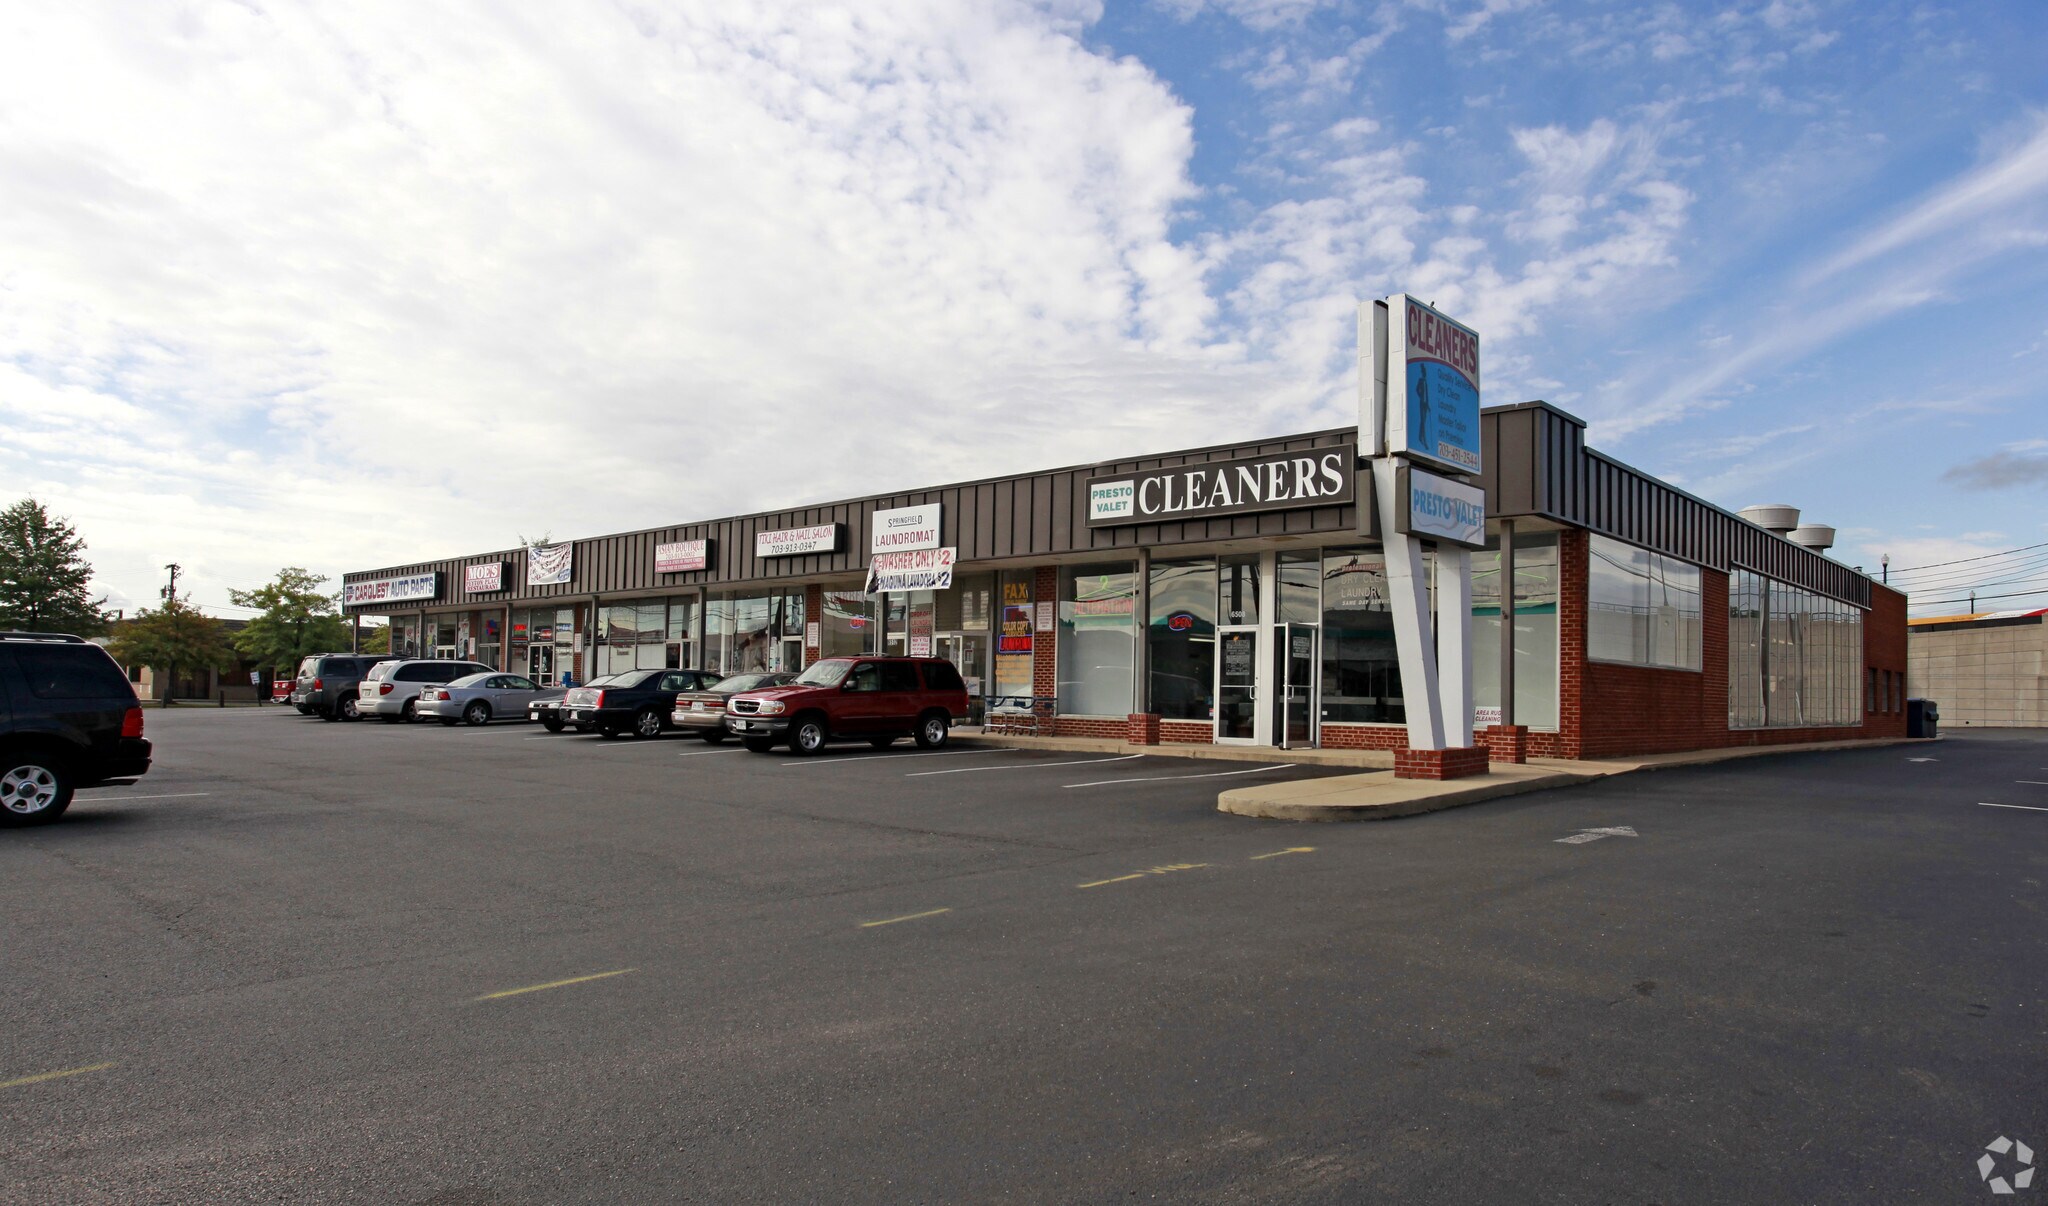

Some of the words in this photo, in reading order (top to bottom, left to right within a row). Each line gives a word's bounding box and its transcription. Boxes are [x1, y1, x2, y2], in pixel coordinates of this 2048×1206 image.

[1408, 304, 1477, 374] CLEANERS
[1138, 453, 1343, 515] CLEANERS
[1092, 486, 1133, 500] PRESTO
[1096, 501, 1128, 513] VALET
[1413, 488, 1450, 519] PRESTO
[1455, 499, 1483, 527] VALET
[888, 515, 923, 528] SPRINGFIELD
[759, 533, 772, 545] TIKI
[773, 531, 789, 544] HAIR
[790, 531, 794, 542] &
[796, 529, 811, 541] NAIL
[812, 526, 833, 540] SALON
[875, 529, 935, 547] LAUNDROMAT
[657, 544, 674, 555] ASIAN
[675, 540, 705, 553] BOUTIQUE
[771, 541, 817, 554] 703-913-0347
[881, 552, 913, 571] WASHER
[916, 550, 936, 568] ONLY
[468, 565, 498, 580] MOE'S
[1341, 575, 1358, 585] DRY
[1362, 573, 1387, 584] CLEA
[355, 582, 390, 601] CARQUEST
[390, 579, 409, 598] AUTO
[410, 576, 434, 596] PARTS
[467, 584, 498, 592] RESTAURANT
[1004, 583, 1027, 599] FAX
[1341, 586, 1382, 598] LAUNDRY
[1003, 621, 1017, 632] COLOR
[1017, 621, 1028, 631] COPY
[1169, 617, 1193, 628] OPEN
